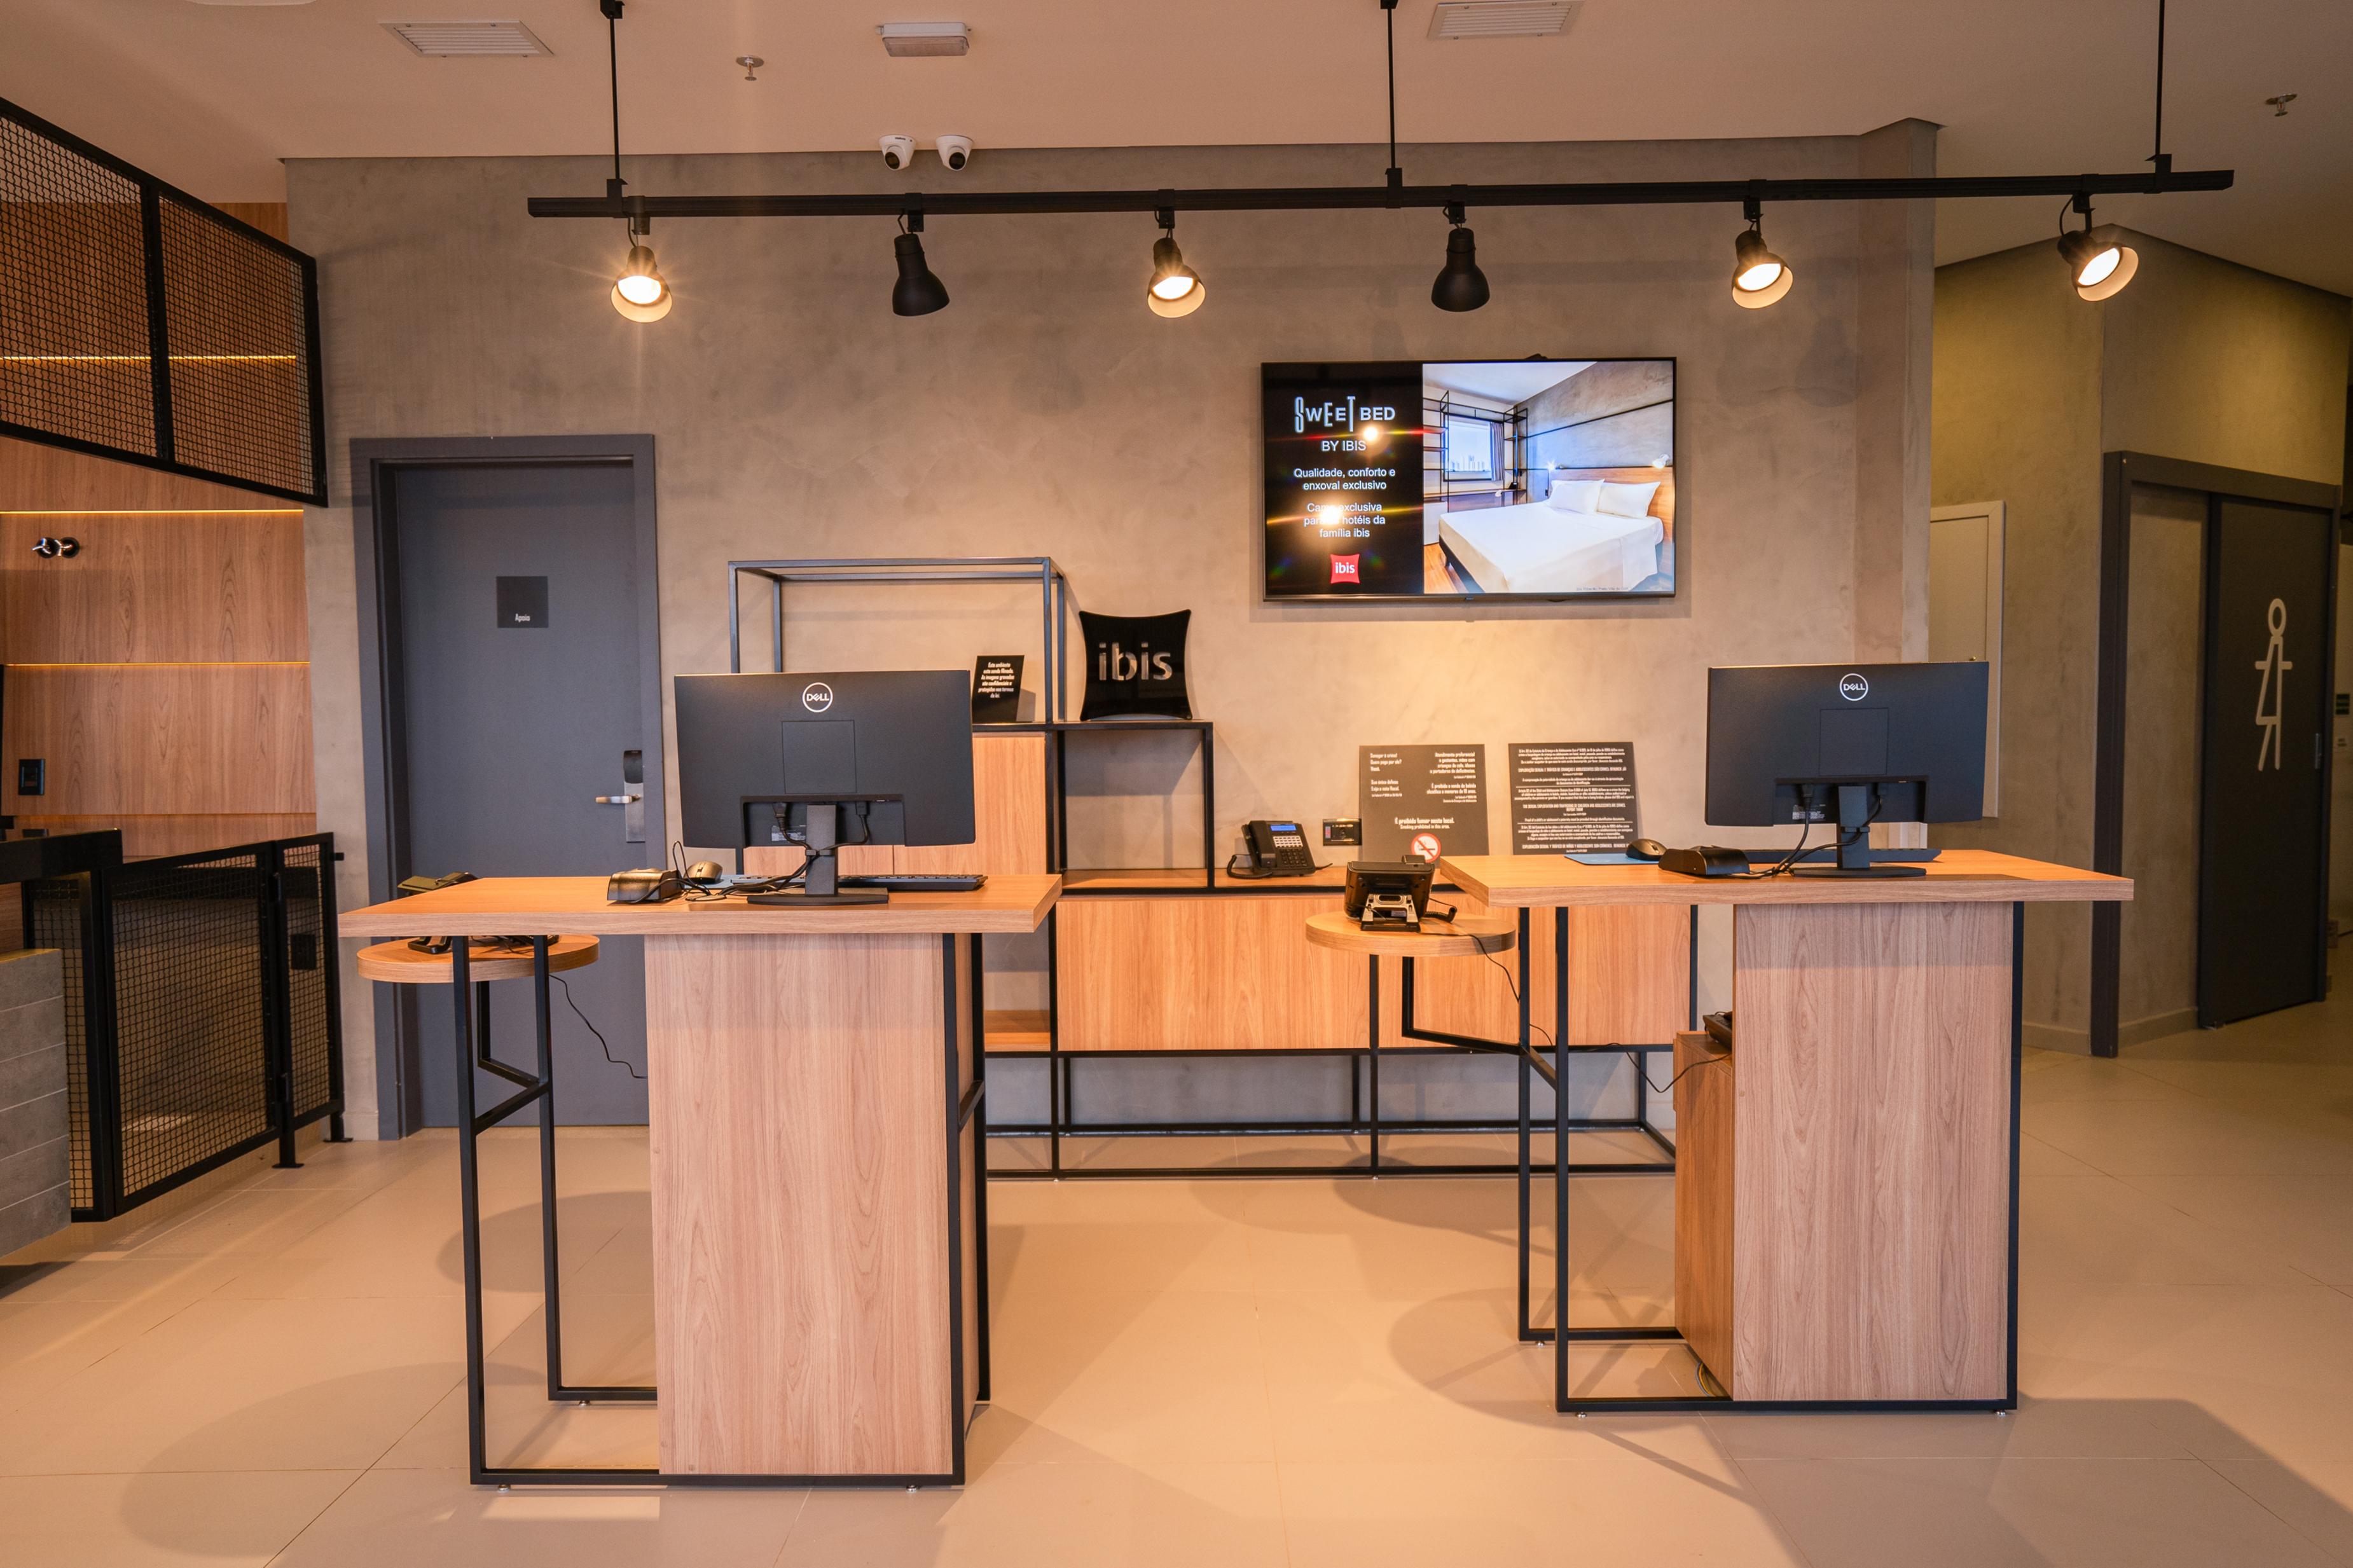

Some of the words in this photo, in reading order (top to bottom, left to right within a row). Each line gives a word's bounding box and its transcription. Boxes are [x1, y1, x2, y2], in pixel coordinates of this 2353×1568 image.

[1294, 395, 1356, 433] SWEET
[1360, 407, 1395, 421] BED
[1321, 441, 1339, 451] BY
[1342, 440, 1367, 451] IBIS
[1294, 468, 1345, 478] Qualidade,
[1348, 467, 1387, 477] conforto
[1303, 481, 1340, 490] enxoval
[1342, 481, 1386, 490] exclusivo
[1339, 502, 1382, 512] exclusiva
[1342, 515, 1370, 525] hotéis
[1373, 516, 1386, 525] da
[1320, 528, 1351, 537] família
[1353, 528, 1370, 537] ibis
[1335, 561, 1355, 574] ibis
[515, 614, 530, 622] Apoio
[1099, 642, 1173, 681] ibis
[1844, 683, 1865, 691] DELL
[806, 693, 829, 701] DELL
